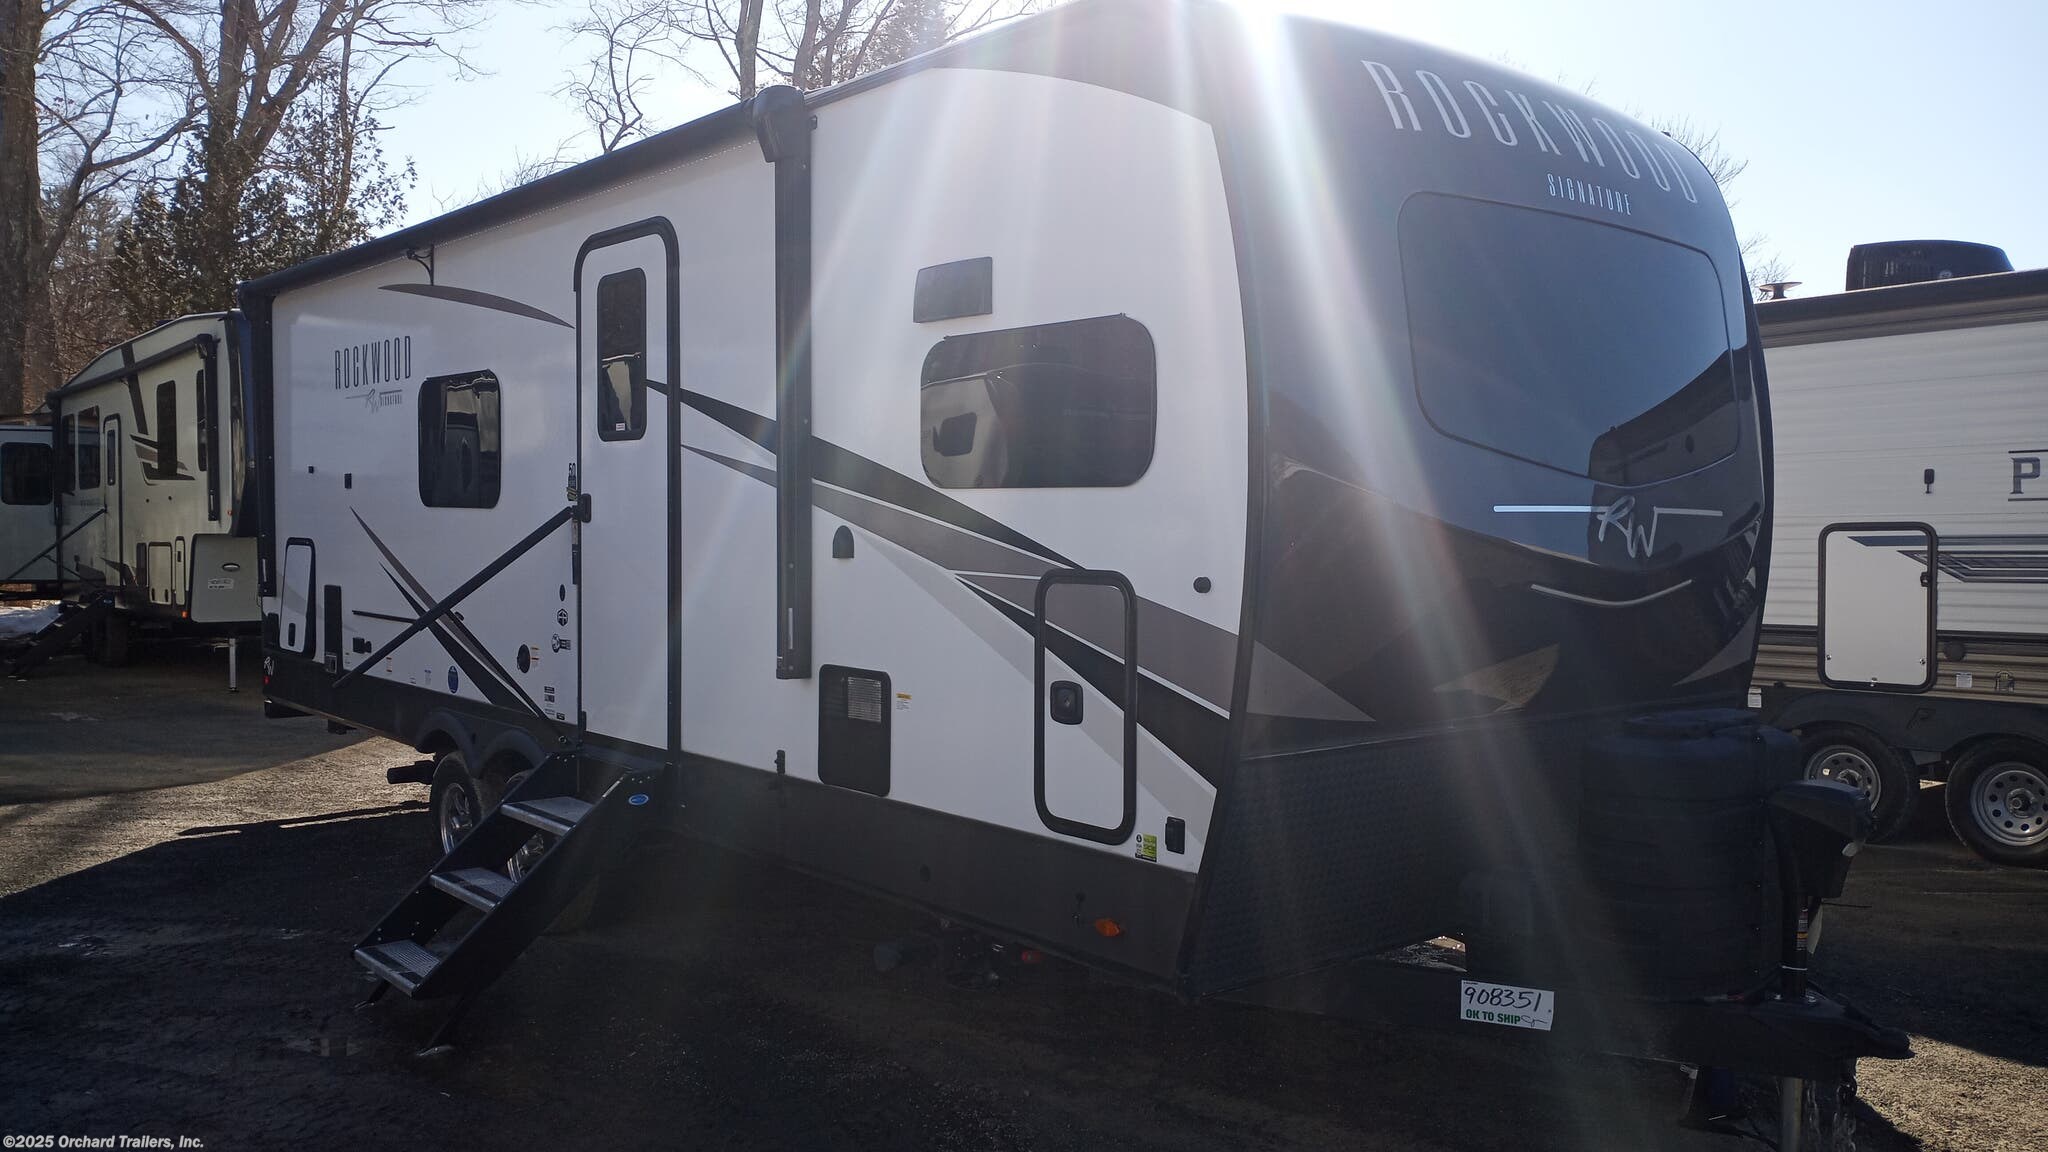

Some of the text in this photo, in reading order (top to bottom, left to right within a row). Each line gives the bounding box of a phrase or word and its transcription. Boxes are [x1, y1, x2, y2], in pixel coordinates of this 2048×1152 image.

[1361, 60, 1698, 203] ROCKWOOD
[1547, 173, 1632, 216] SIGNATURE
[335, 336, 411, 389] ROCKWOOD
[1464, 986, 1542, 1012] 908351
[1466, 1009, 1480, 1020] OK
[1482, 1010, 1495, 1022] TO
[1497, 1013, 1521, 1025] SHIP
